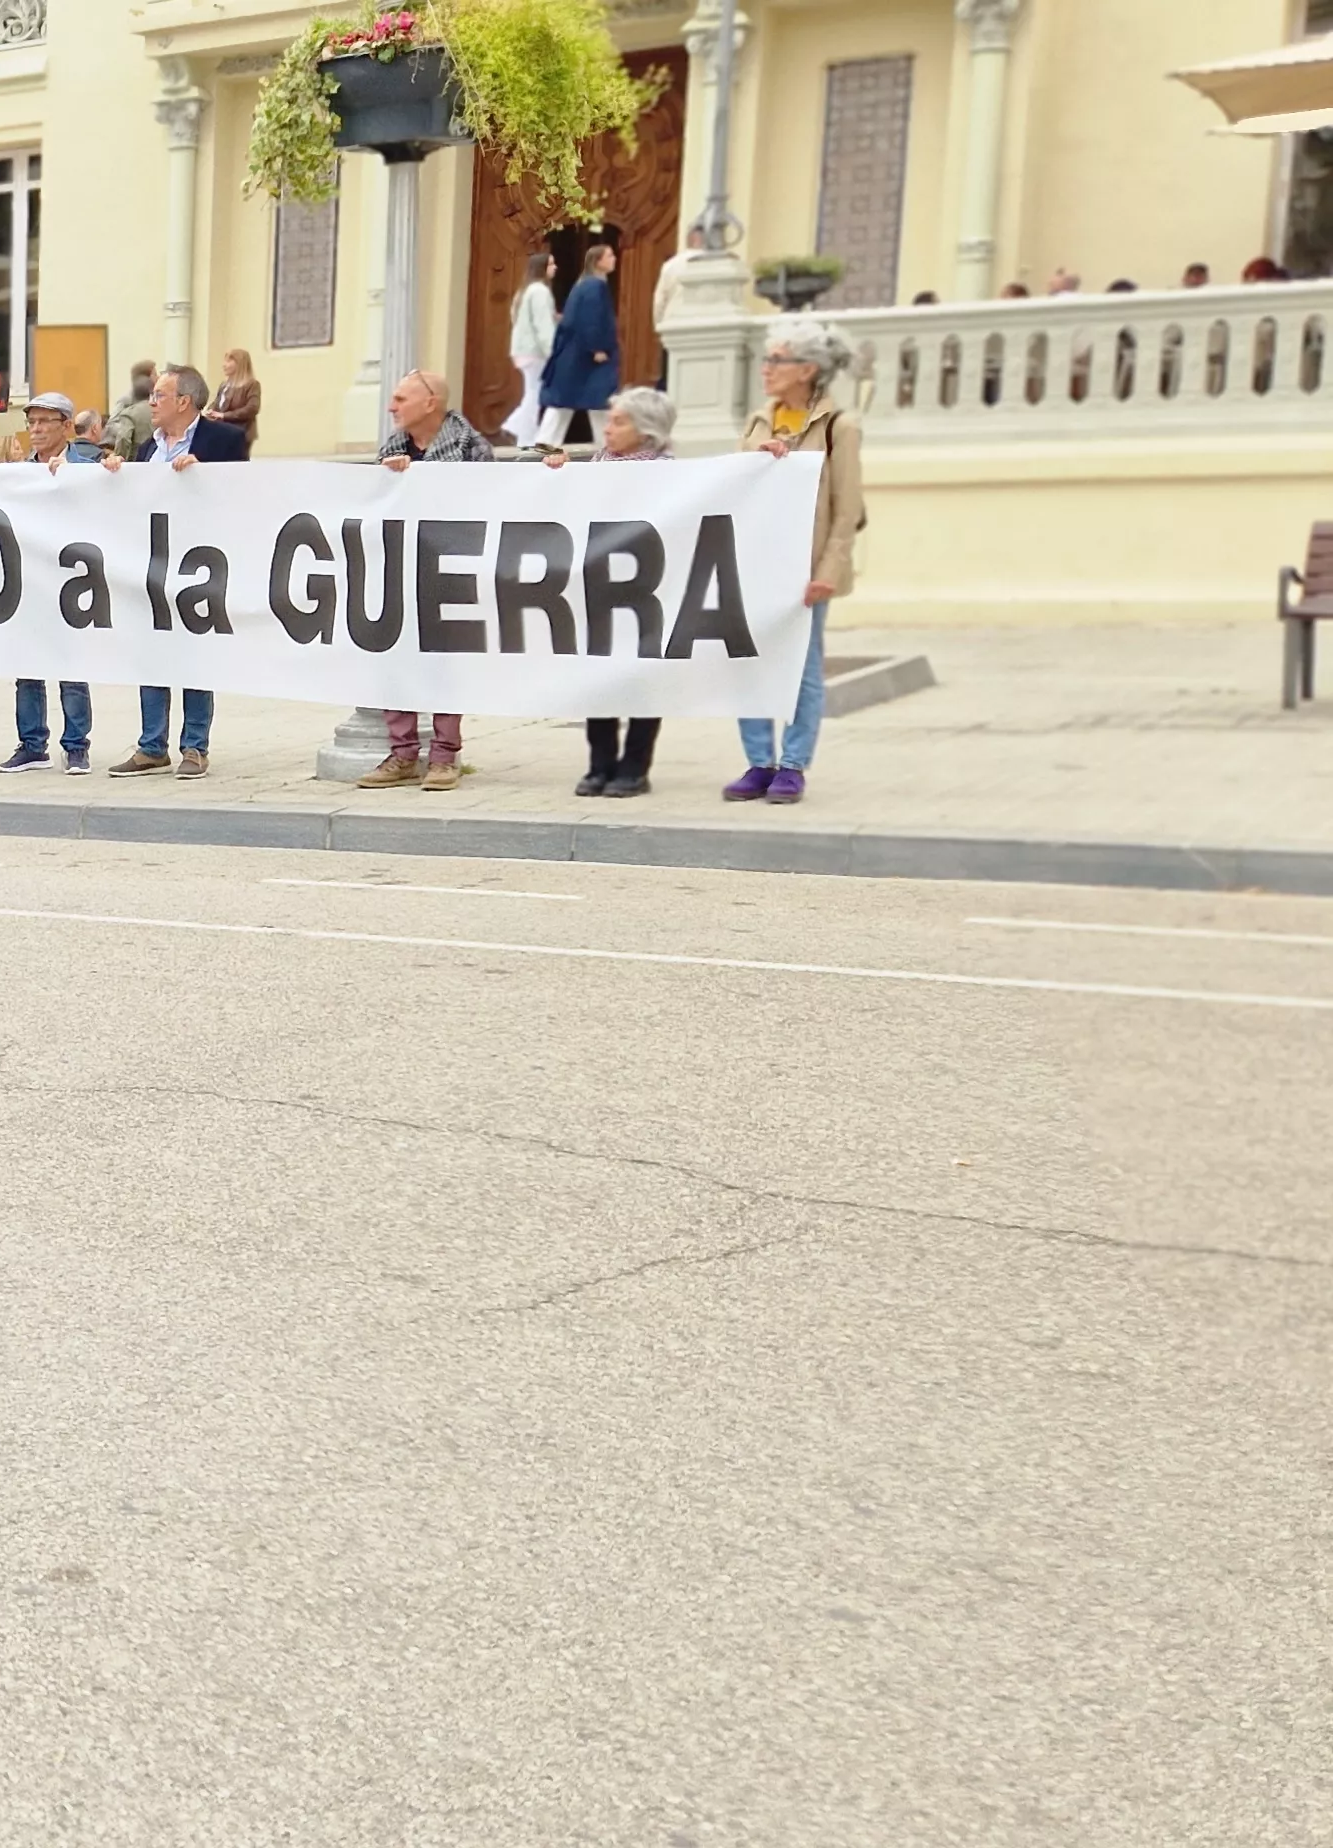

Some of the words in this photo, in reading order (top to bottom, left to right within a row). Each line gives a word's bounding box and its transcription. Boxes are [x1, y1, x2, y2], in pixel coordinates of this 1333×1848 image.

[58, 541, 113, 630] a
[146, 512, 234, 635] la
[268, 512, 760, 660] GUERRA
